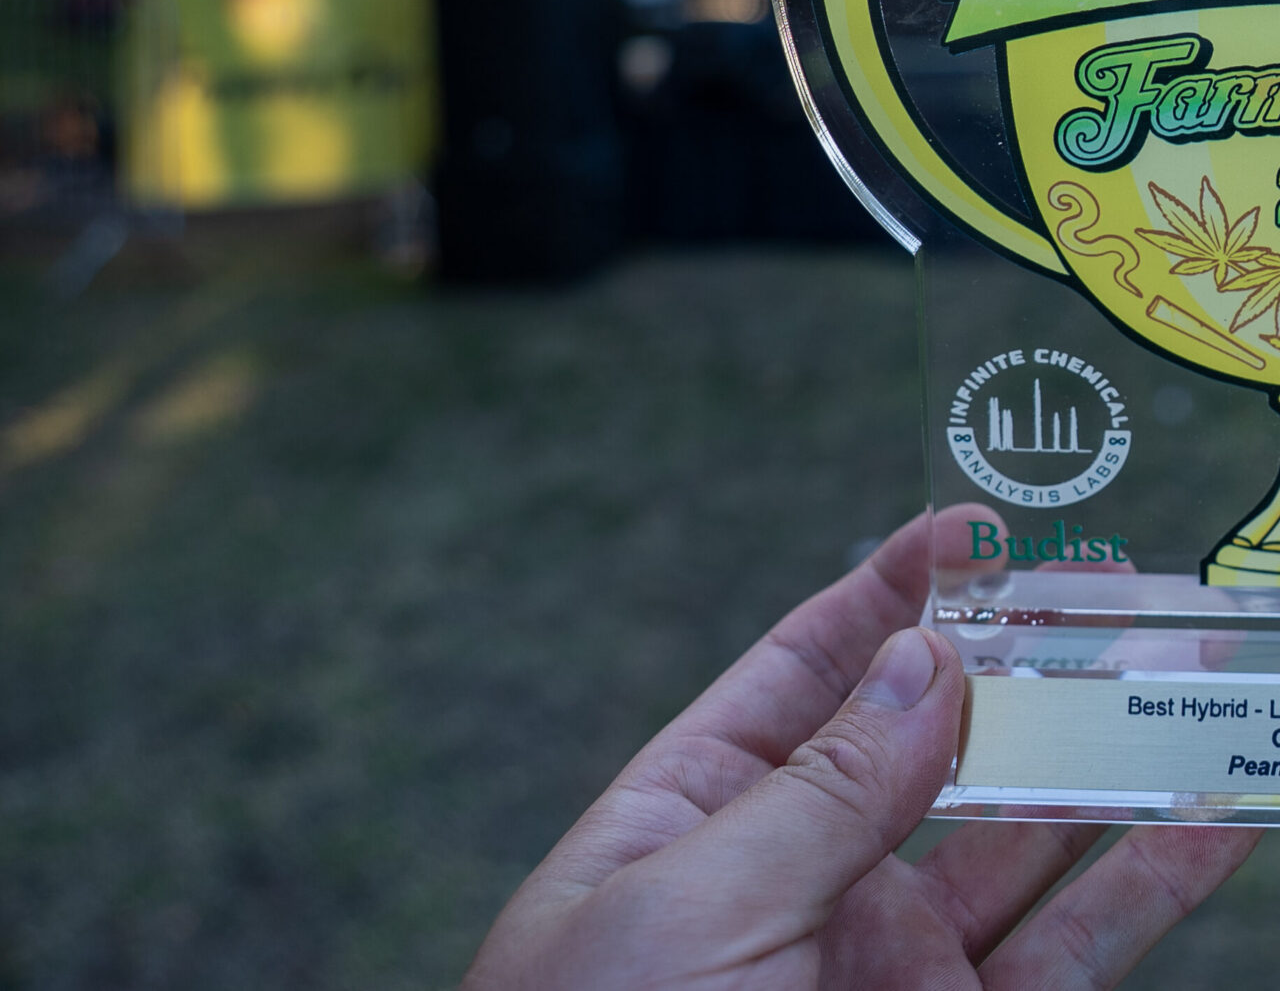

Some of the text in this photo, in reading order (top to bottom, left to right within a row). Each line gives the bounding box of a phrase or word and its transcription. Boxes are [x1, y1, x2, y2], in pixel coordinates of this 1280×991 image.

[949, 348, 1129, 428] INFINITE CHEMICAL
[959, 449, 1120, 503] ANALYSIS LABS
[967, 520, 1128, 562] Budist
[1128, 696, 1175, 716] Best
[1181, 697, 1248, 722] Hybrid
